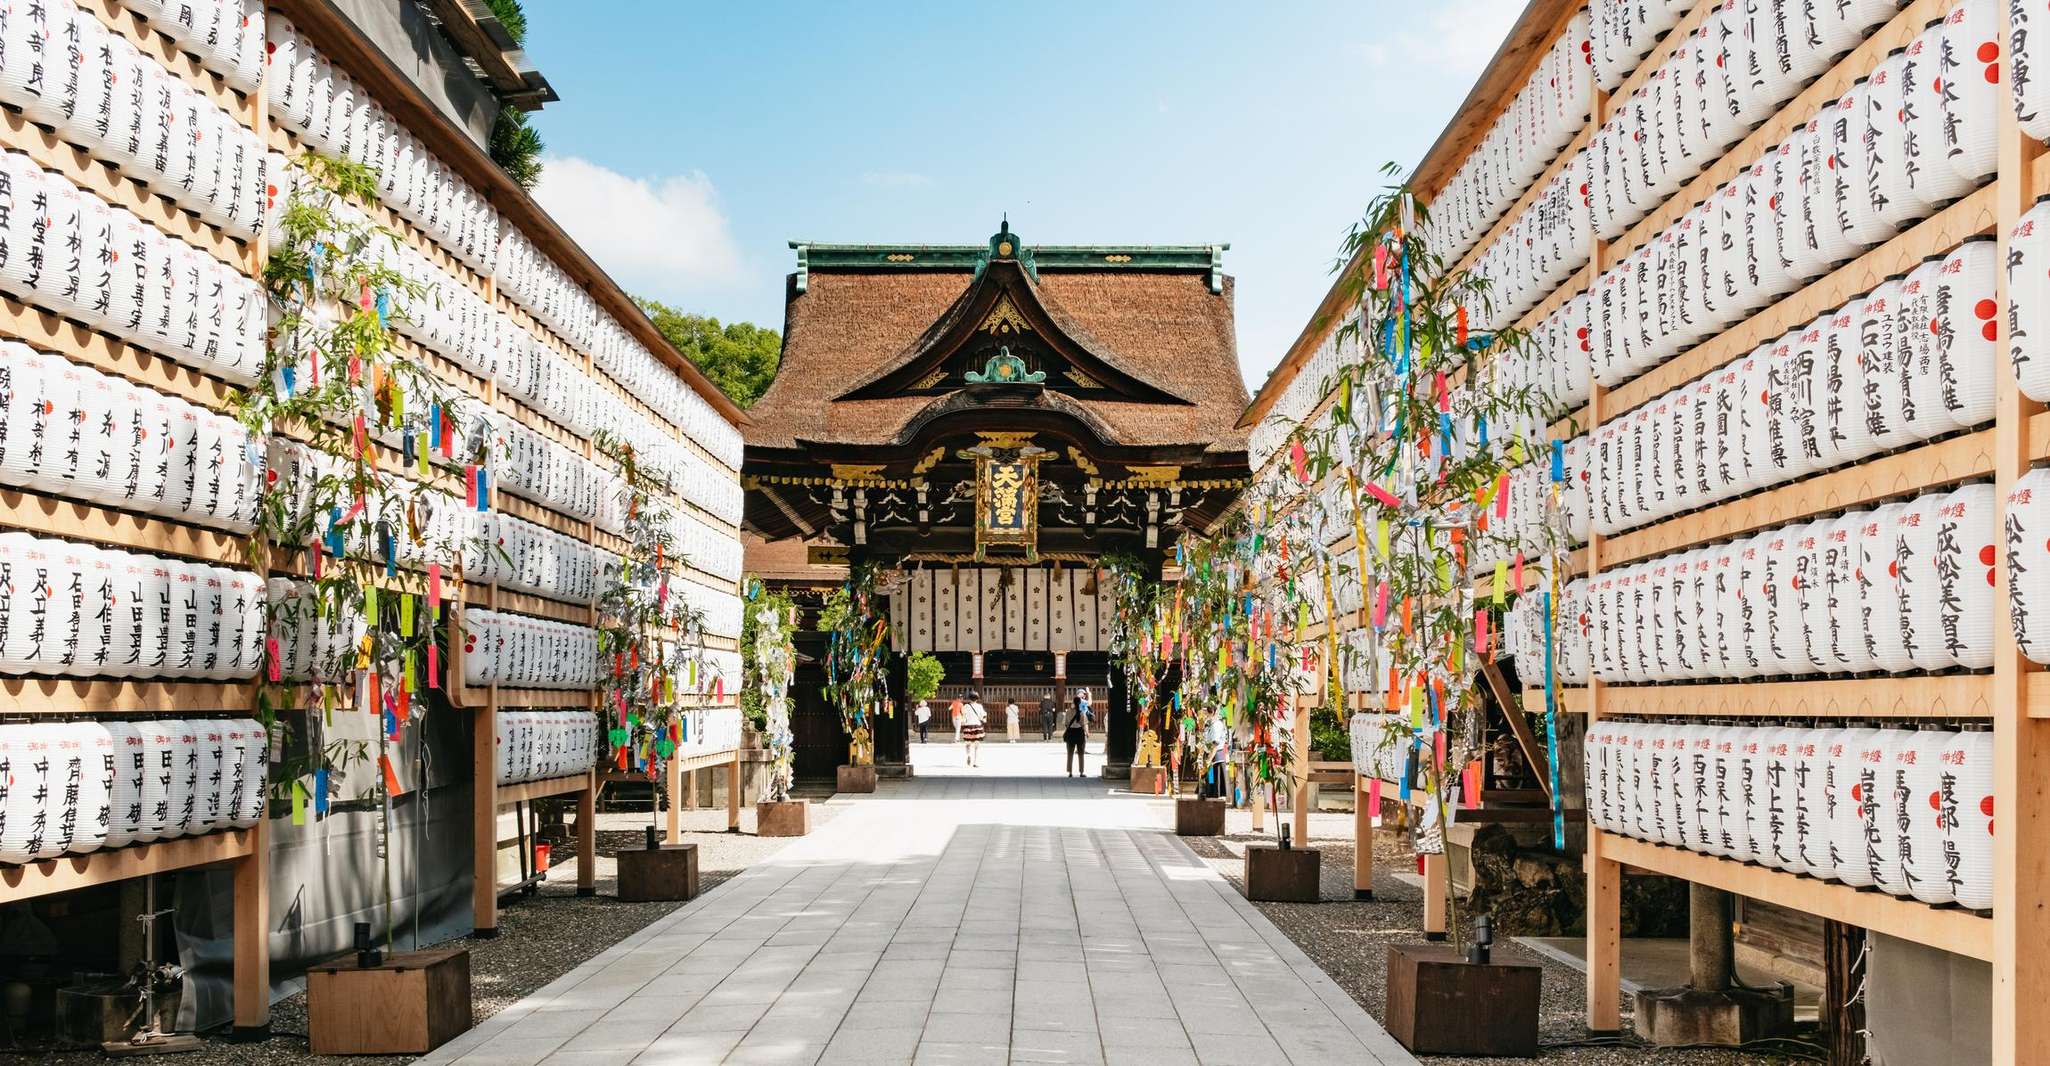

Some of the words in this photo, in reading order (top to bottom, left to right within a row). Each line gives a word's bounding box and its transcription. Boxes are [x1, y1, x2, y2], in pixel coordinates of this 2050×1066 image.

[1882, 314, 1894, 374] ユウコウ建装
